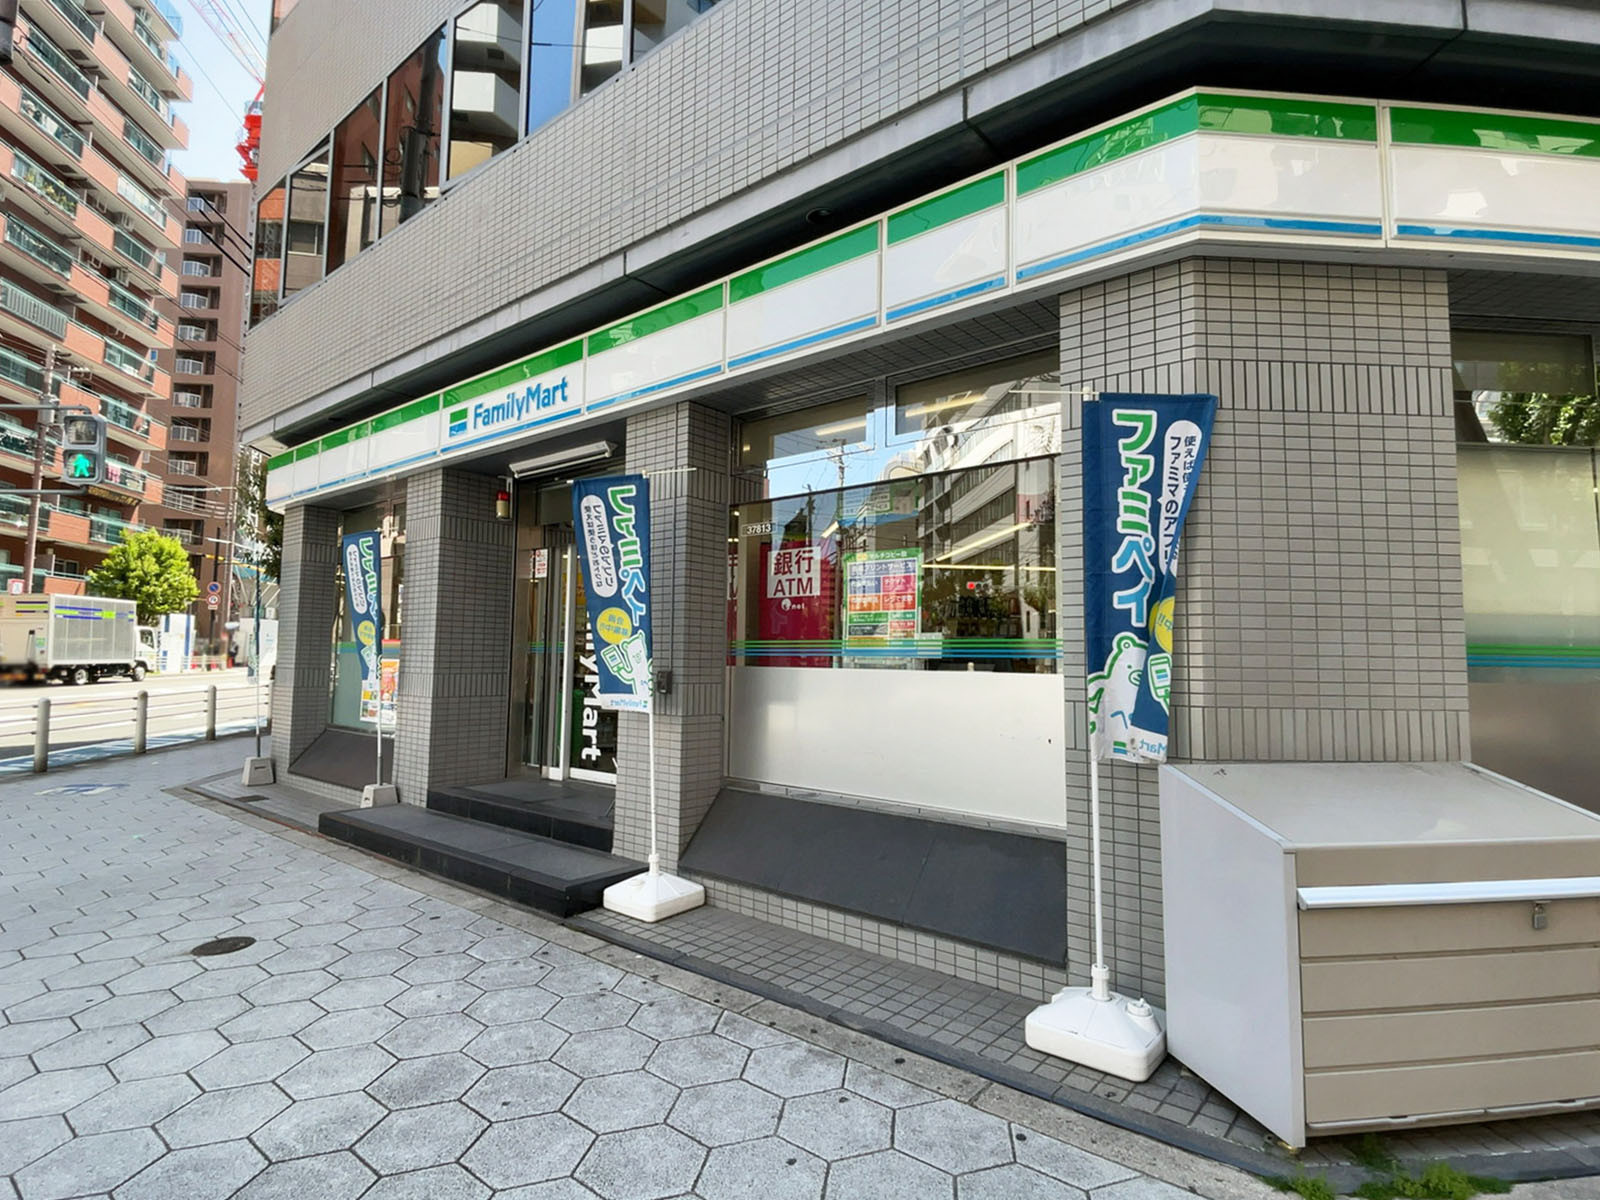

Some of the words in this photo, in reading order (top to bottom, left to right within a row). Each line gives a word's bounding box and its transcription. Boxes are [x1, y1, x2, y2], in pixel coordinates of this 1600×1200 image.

[473, 376, 568, 430] FamilyMart
[746, 524, 772, 534] 37813
[1113, 409, 1156, 626] ファミペイ
[773, 549, 814, 576] 銀行
[773, 577, 813, 596] ATM
